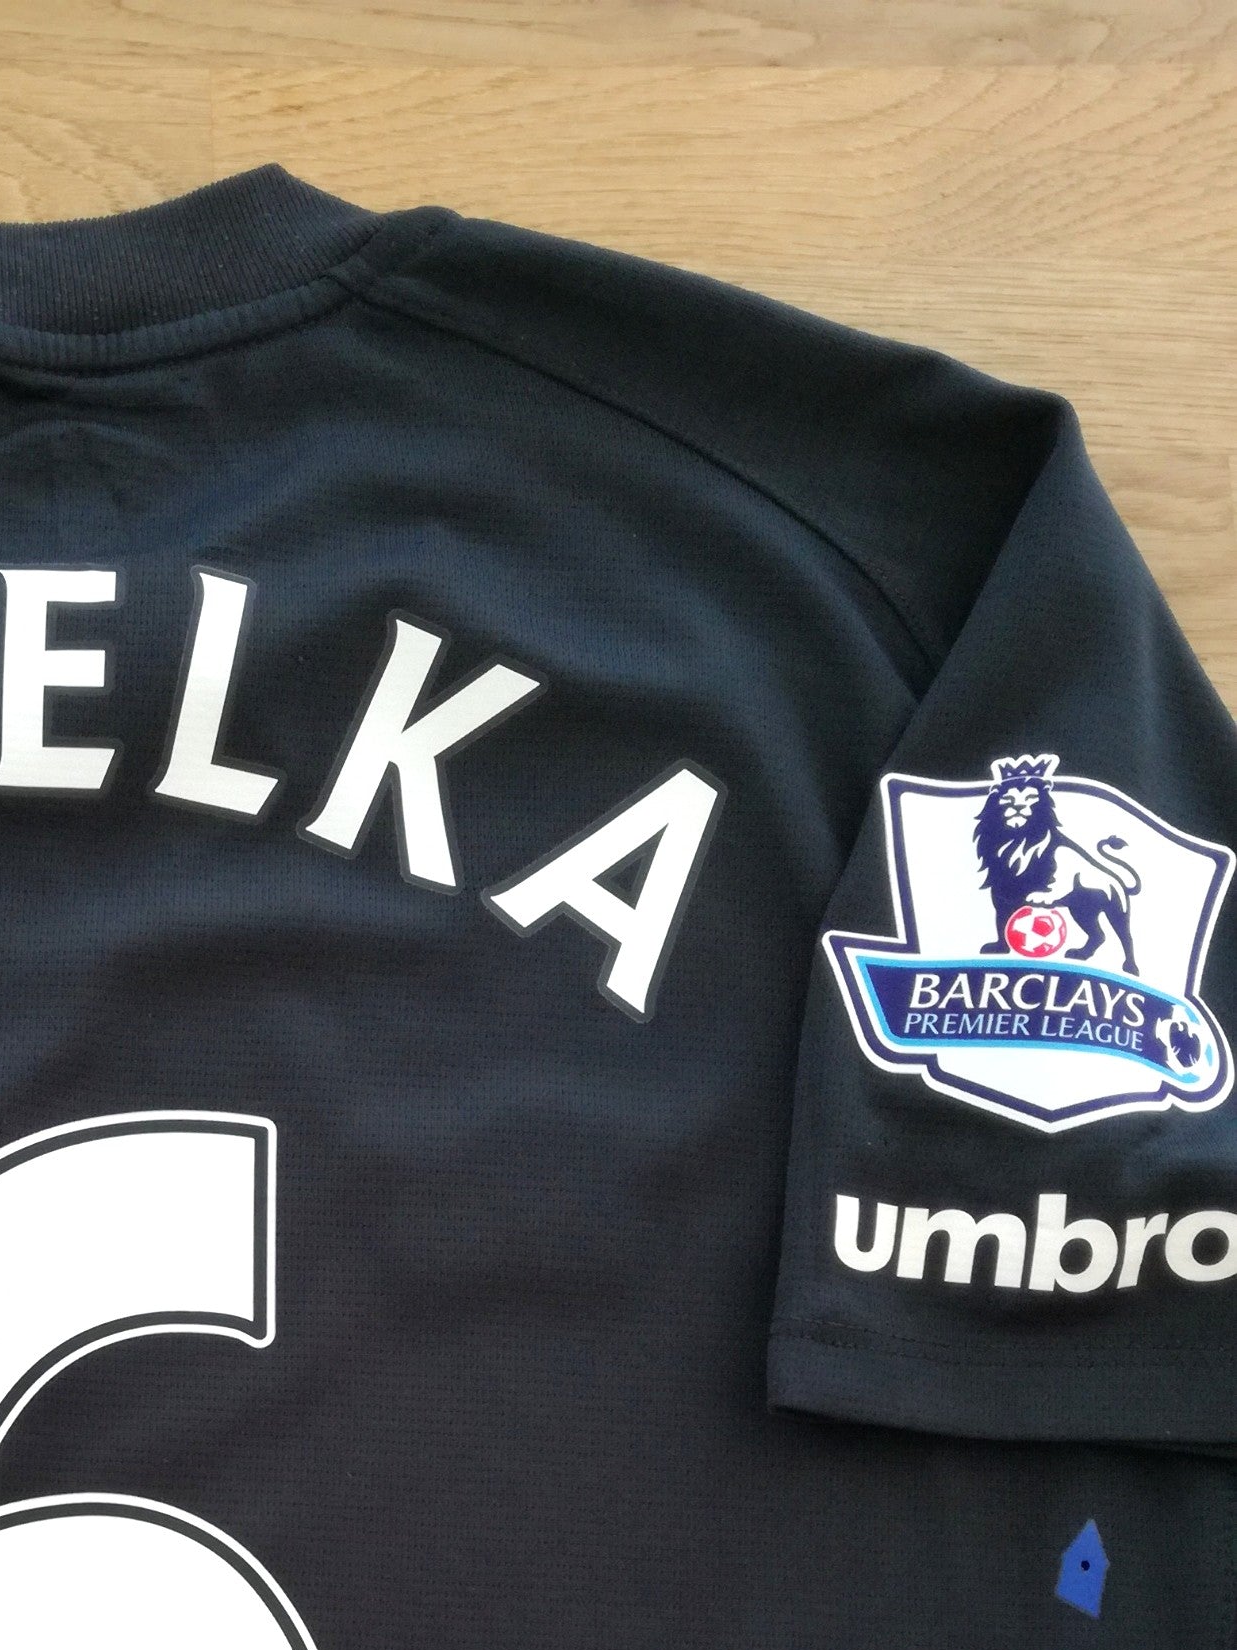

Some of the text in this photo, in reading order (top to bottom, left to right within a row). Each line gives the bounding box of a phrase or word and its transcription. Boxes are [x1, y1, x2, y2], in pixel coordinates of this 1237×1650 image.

[909, 973, 1146, 1027] BARCLAYS
[904, 1012, 1144, 1051] PREMIER LEAGUE
[834, 1193, 1237, 1294] umbro
